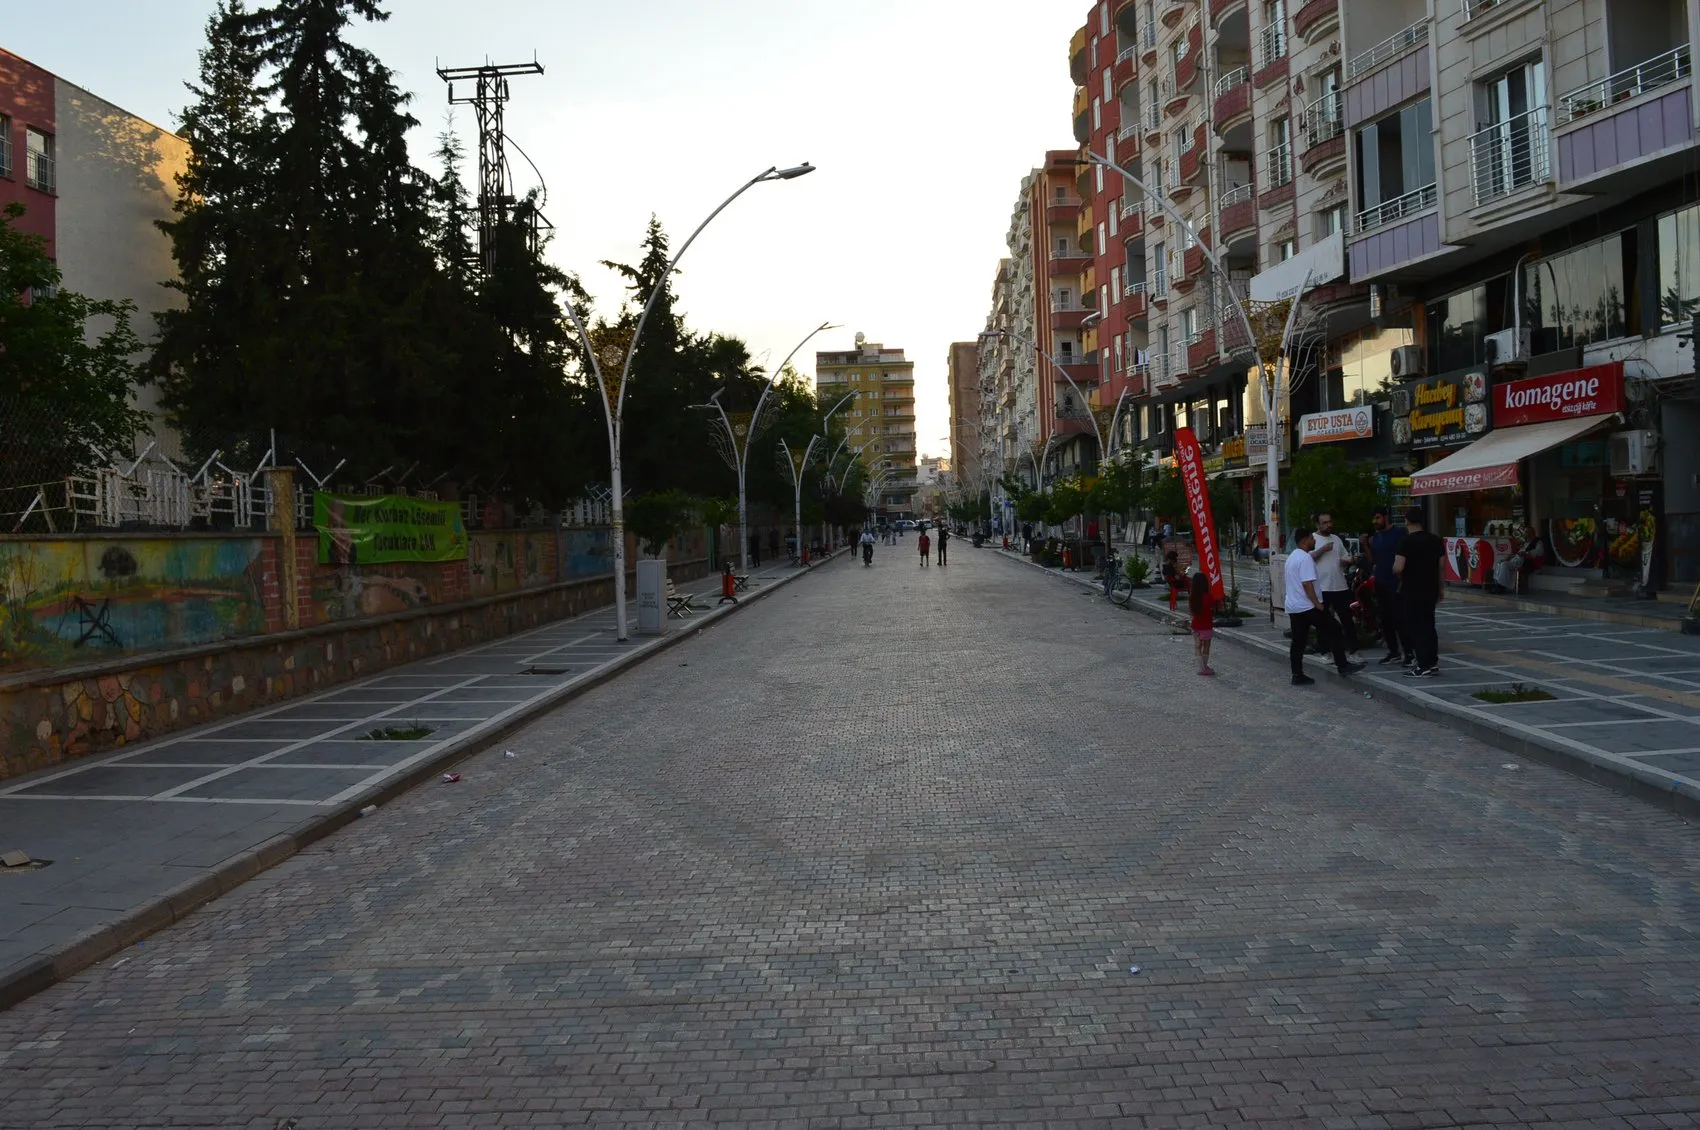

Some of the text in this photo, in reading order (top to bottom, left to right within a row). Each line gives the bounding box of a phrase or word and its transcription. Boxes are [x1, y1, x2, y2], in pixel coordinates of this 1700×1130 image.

[1505, 377, 1599, 410] komagene
[1307, 413, 1353, 431] EYÜP USTA
[1413, 473, 1482, 490] komagene
